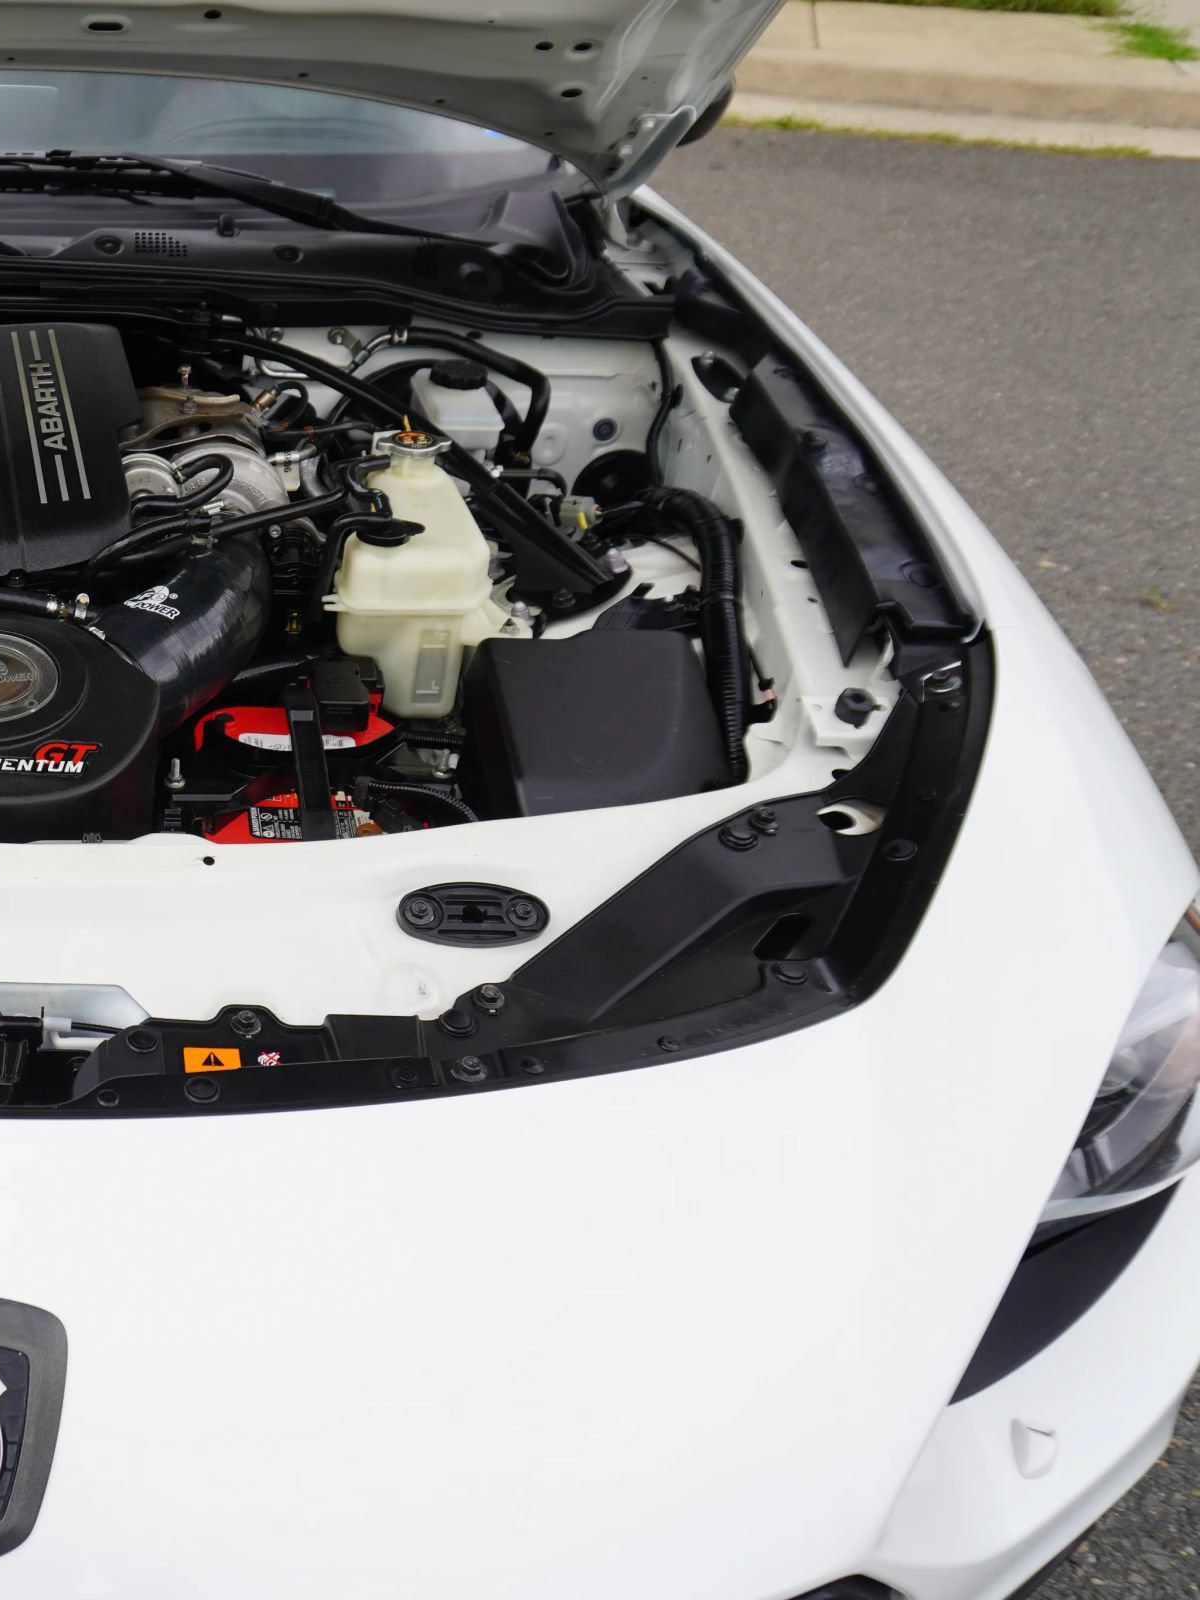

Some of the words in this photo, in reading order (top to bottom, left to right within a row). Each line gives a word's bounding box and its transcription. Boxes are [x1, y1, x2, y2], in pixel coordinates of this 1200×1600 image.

[29, 362, 68, 451] ABARTH
[135, 602, 179, 618] POWER
[35, 741, 98, 764] GT
